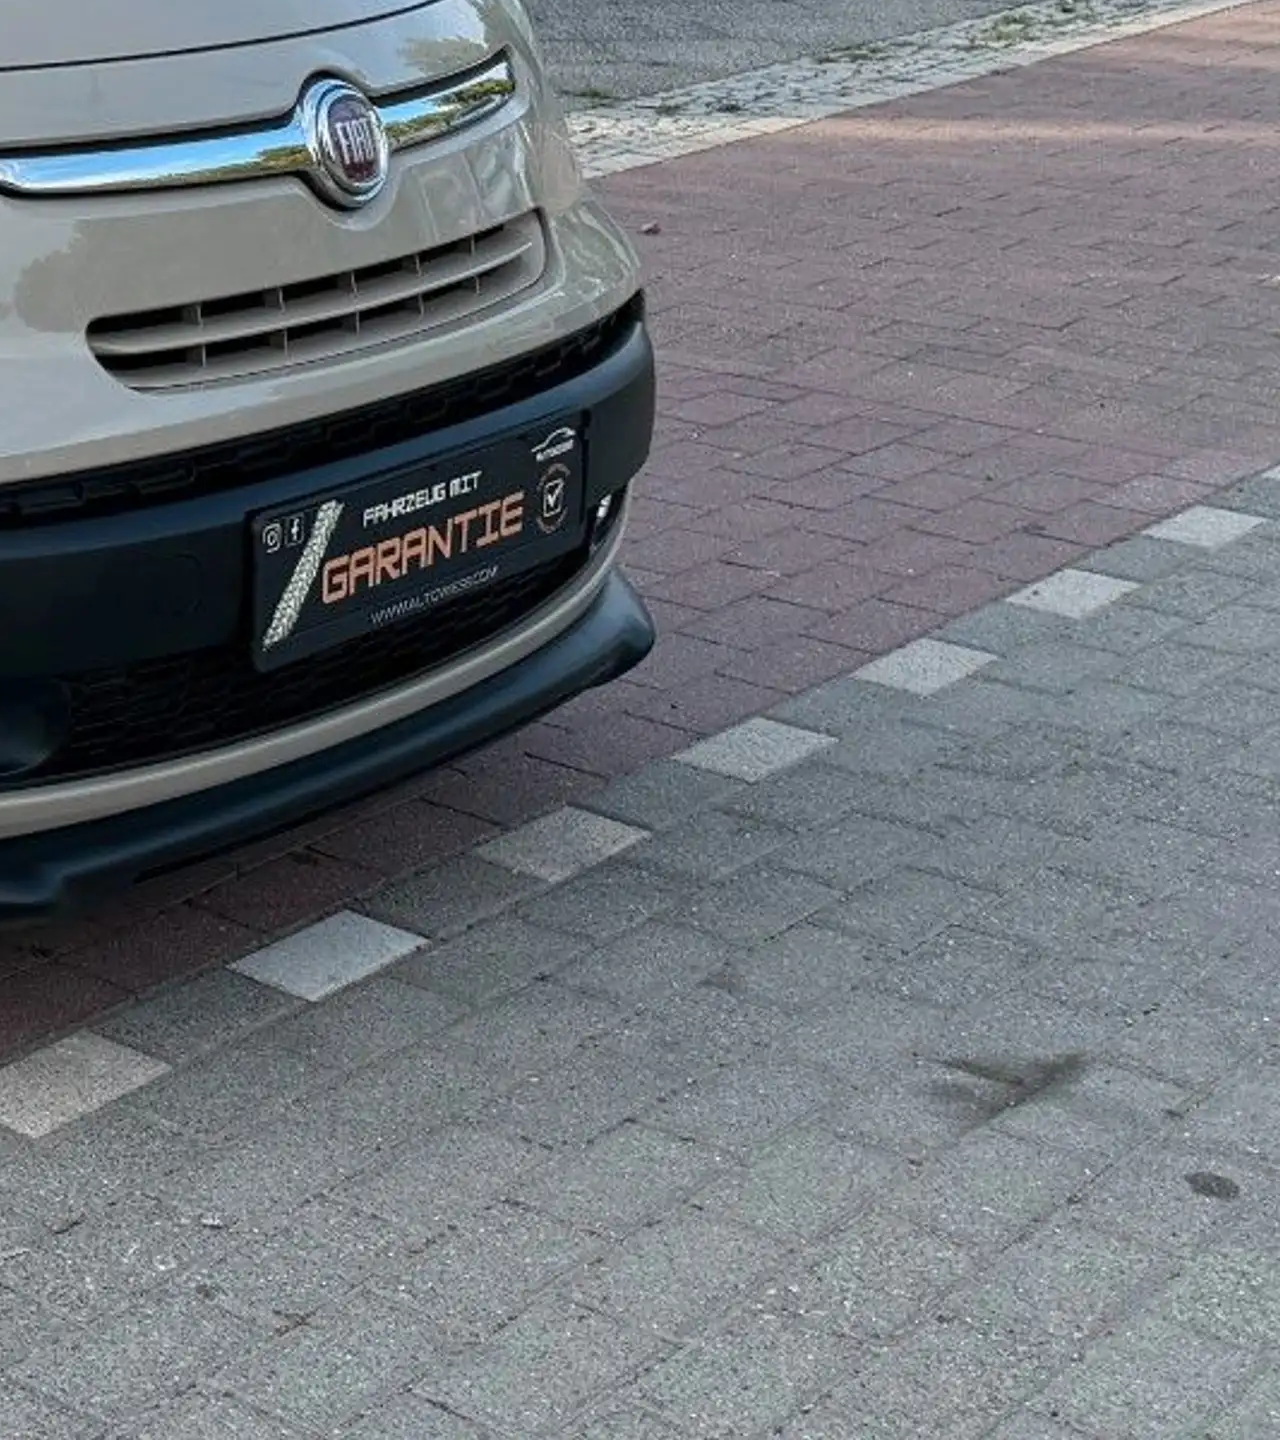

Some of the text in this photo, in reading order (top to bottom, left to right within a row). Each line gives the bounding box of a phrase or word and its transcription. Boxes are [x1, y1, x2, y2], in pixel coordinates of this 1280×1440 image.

[335, 116, 379, 164] FIAT
[362, 470, 483, 527] FAHRZEUG MIT
[322, 490, 525, 604] GARANTIE
